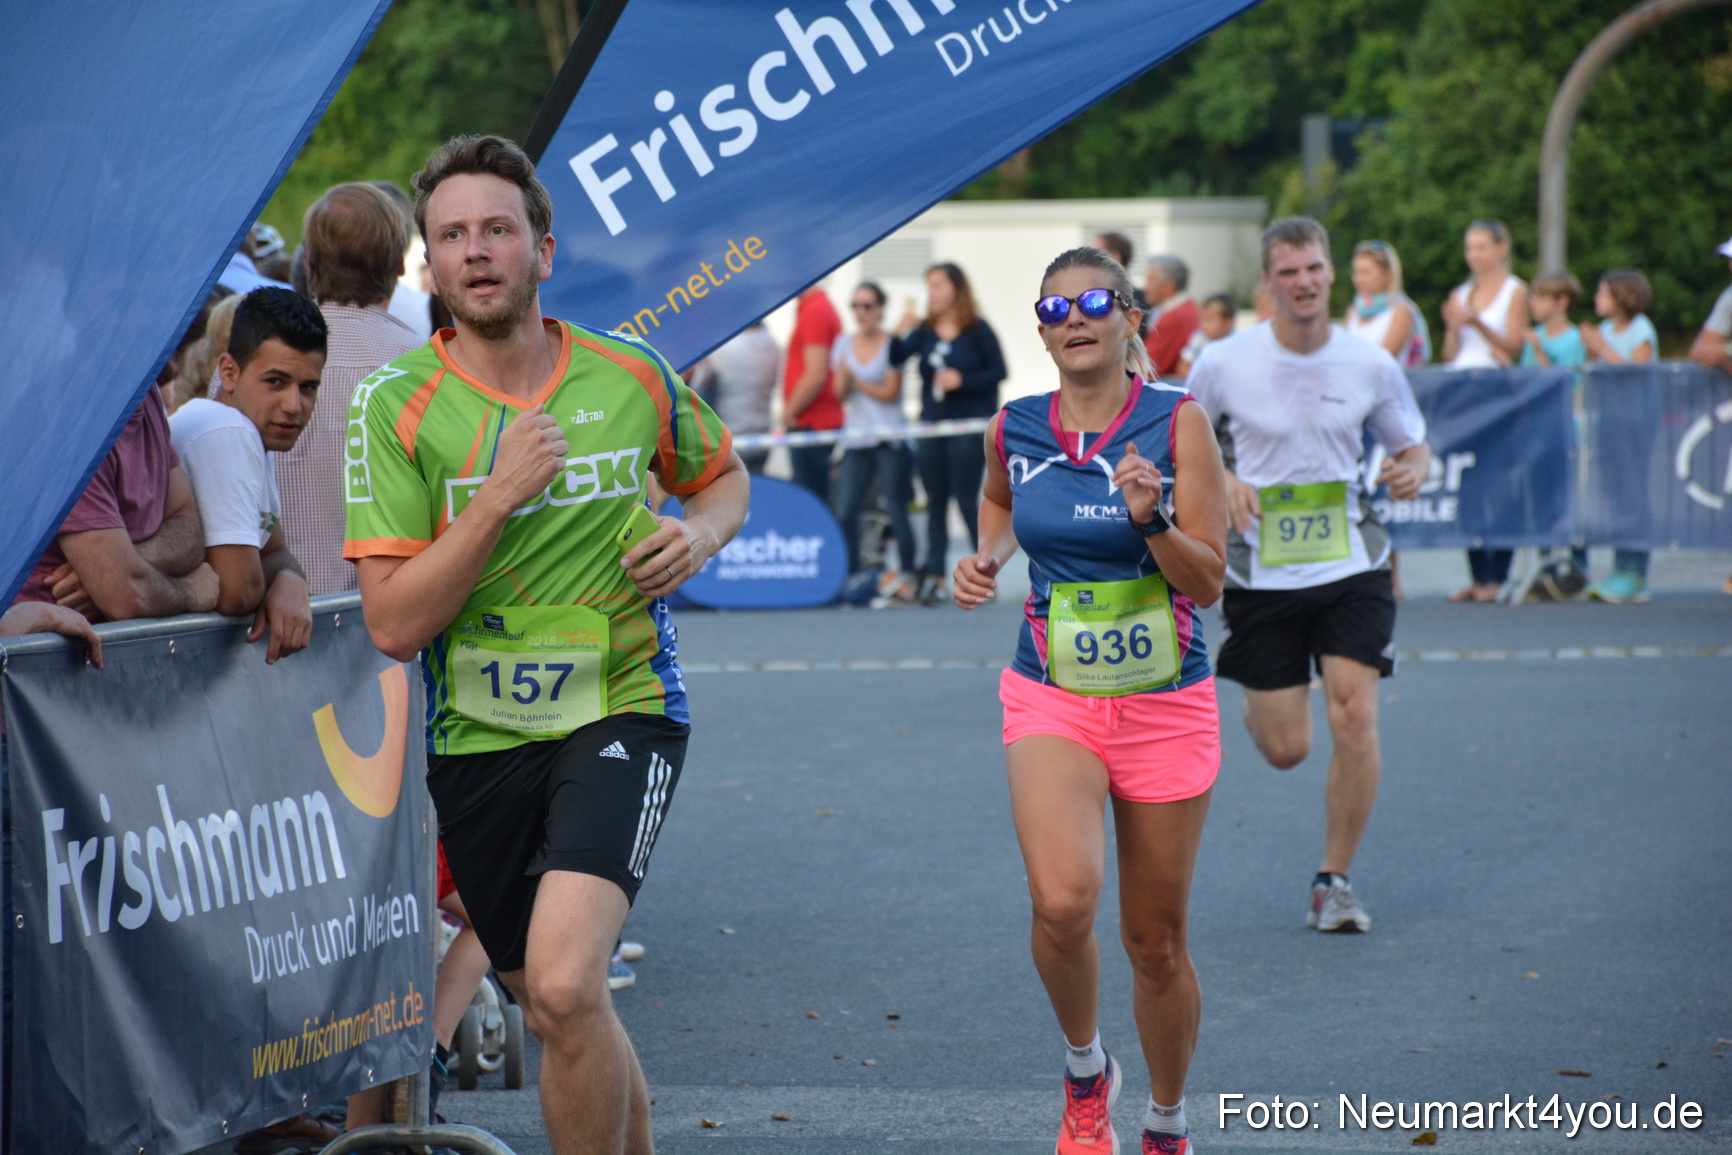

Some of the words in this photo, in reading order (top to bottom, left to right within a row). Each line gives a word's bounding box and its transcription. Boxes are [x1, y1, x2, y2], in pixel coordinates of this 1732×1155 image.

[935, 0, 1072, 77] Druc
[1074, 504, 1117, 518] MCM
[1279, 514, 1331, 542] 973
[474, 625, 525, 640] firmenlauf
[527, 636, 557, 646] 2016
[1075, 623, 1152, 665] 936
[480, 660, 574, 705] 157
[1076, 673, 1096, 681] Silke
[490, 708, 518, 720] Julian
[520, 711, 562, 723] Böhnlein
[599, 751, 630, 760] adidas
[42, 784, 346, 944] Frischmann
[244, 911, 310, 984] Druck
[312, 897, 356, 965] und
